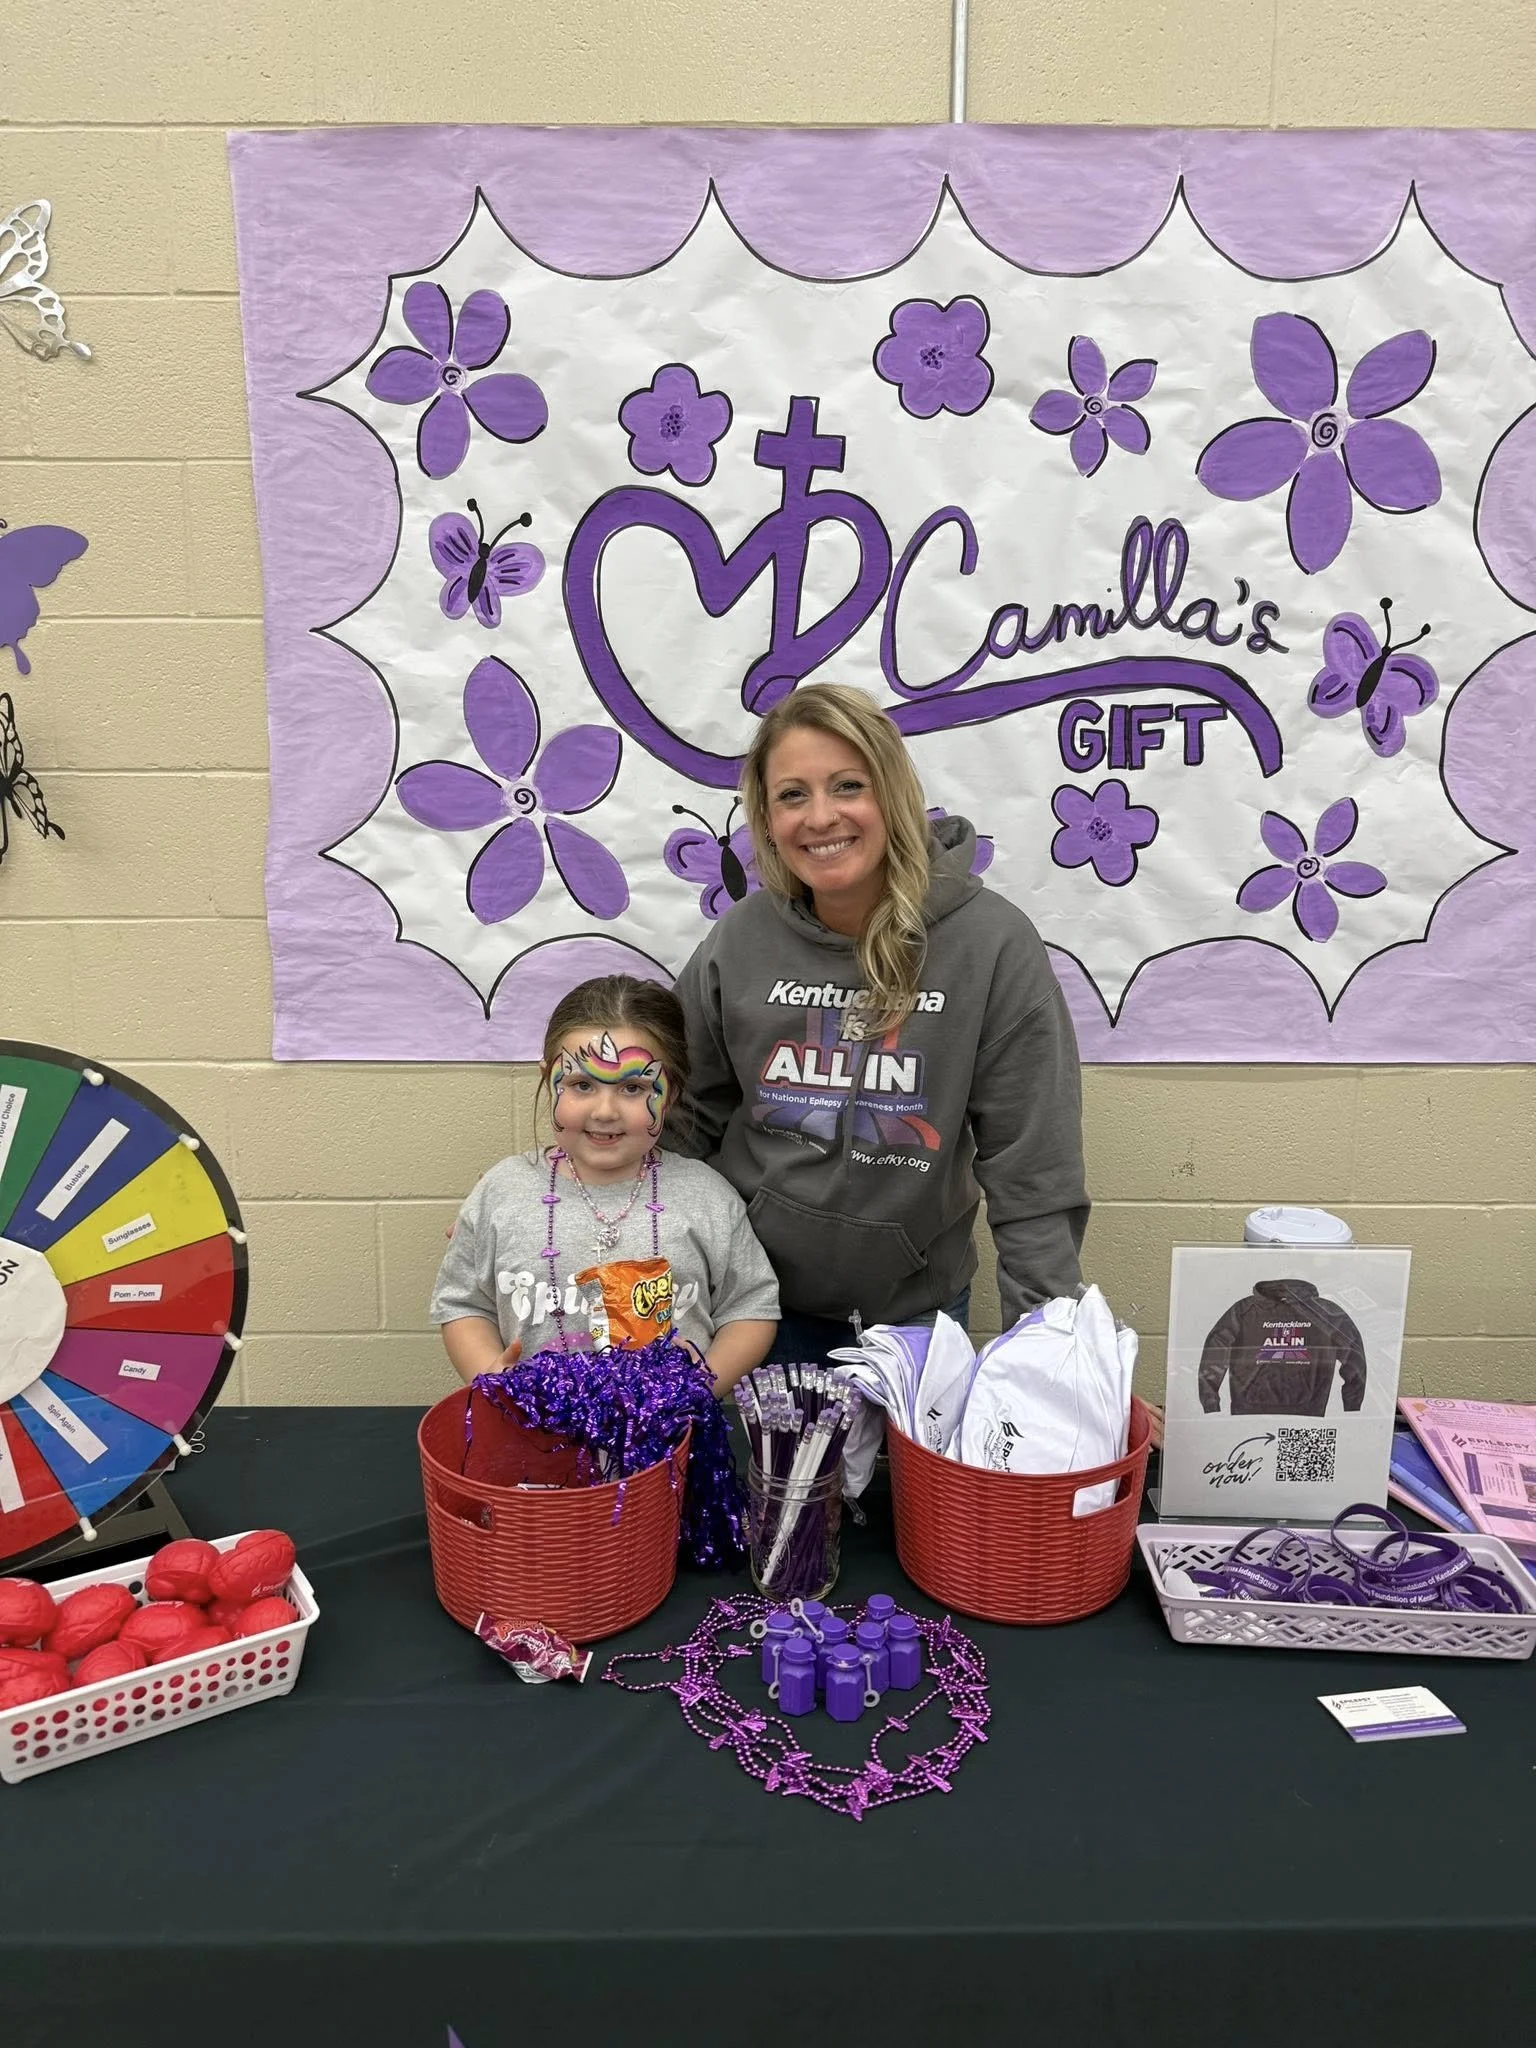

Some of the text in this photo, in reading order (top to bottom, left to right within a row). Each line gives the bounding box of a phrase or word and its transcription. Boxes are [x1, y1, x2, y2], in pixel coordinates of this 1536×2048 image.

[880, 505, 1290, 700] Camilla's
[1058, 698, 1228, 774] GIFT
[764, 1046, 918, 1094] ALL IN
[2, 1093, 16, 1120] Choice
[760, 1089, 770, 1099] for
[772, 1092, 808, 1105] National
[809, 1096, 842, 1109] Epilepsy
[896, 1104, 924, 1113] Month
[64, 1163, 90, 1192] Bubbles
[107, 1221, 152, 1246] Sunglasses
[114, 1290, 131, 1299] Pom
[138, 1290, 156, 1299] Pom
[1263, 1336, 1305, 1347] ALL IN
[123, 1364, 147, 1375] Candy
[47, 1403, 77, 1434] Spin Again
[1467, 1437, 1530, 1449] EPILEPSY
[1202, 1451, 1264, 1475] order
[1209, 1467, 1262, 1489] now!
